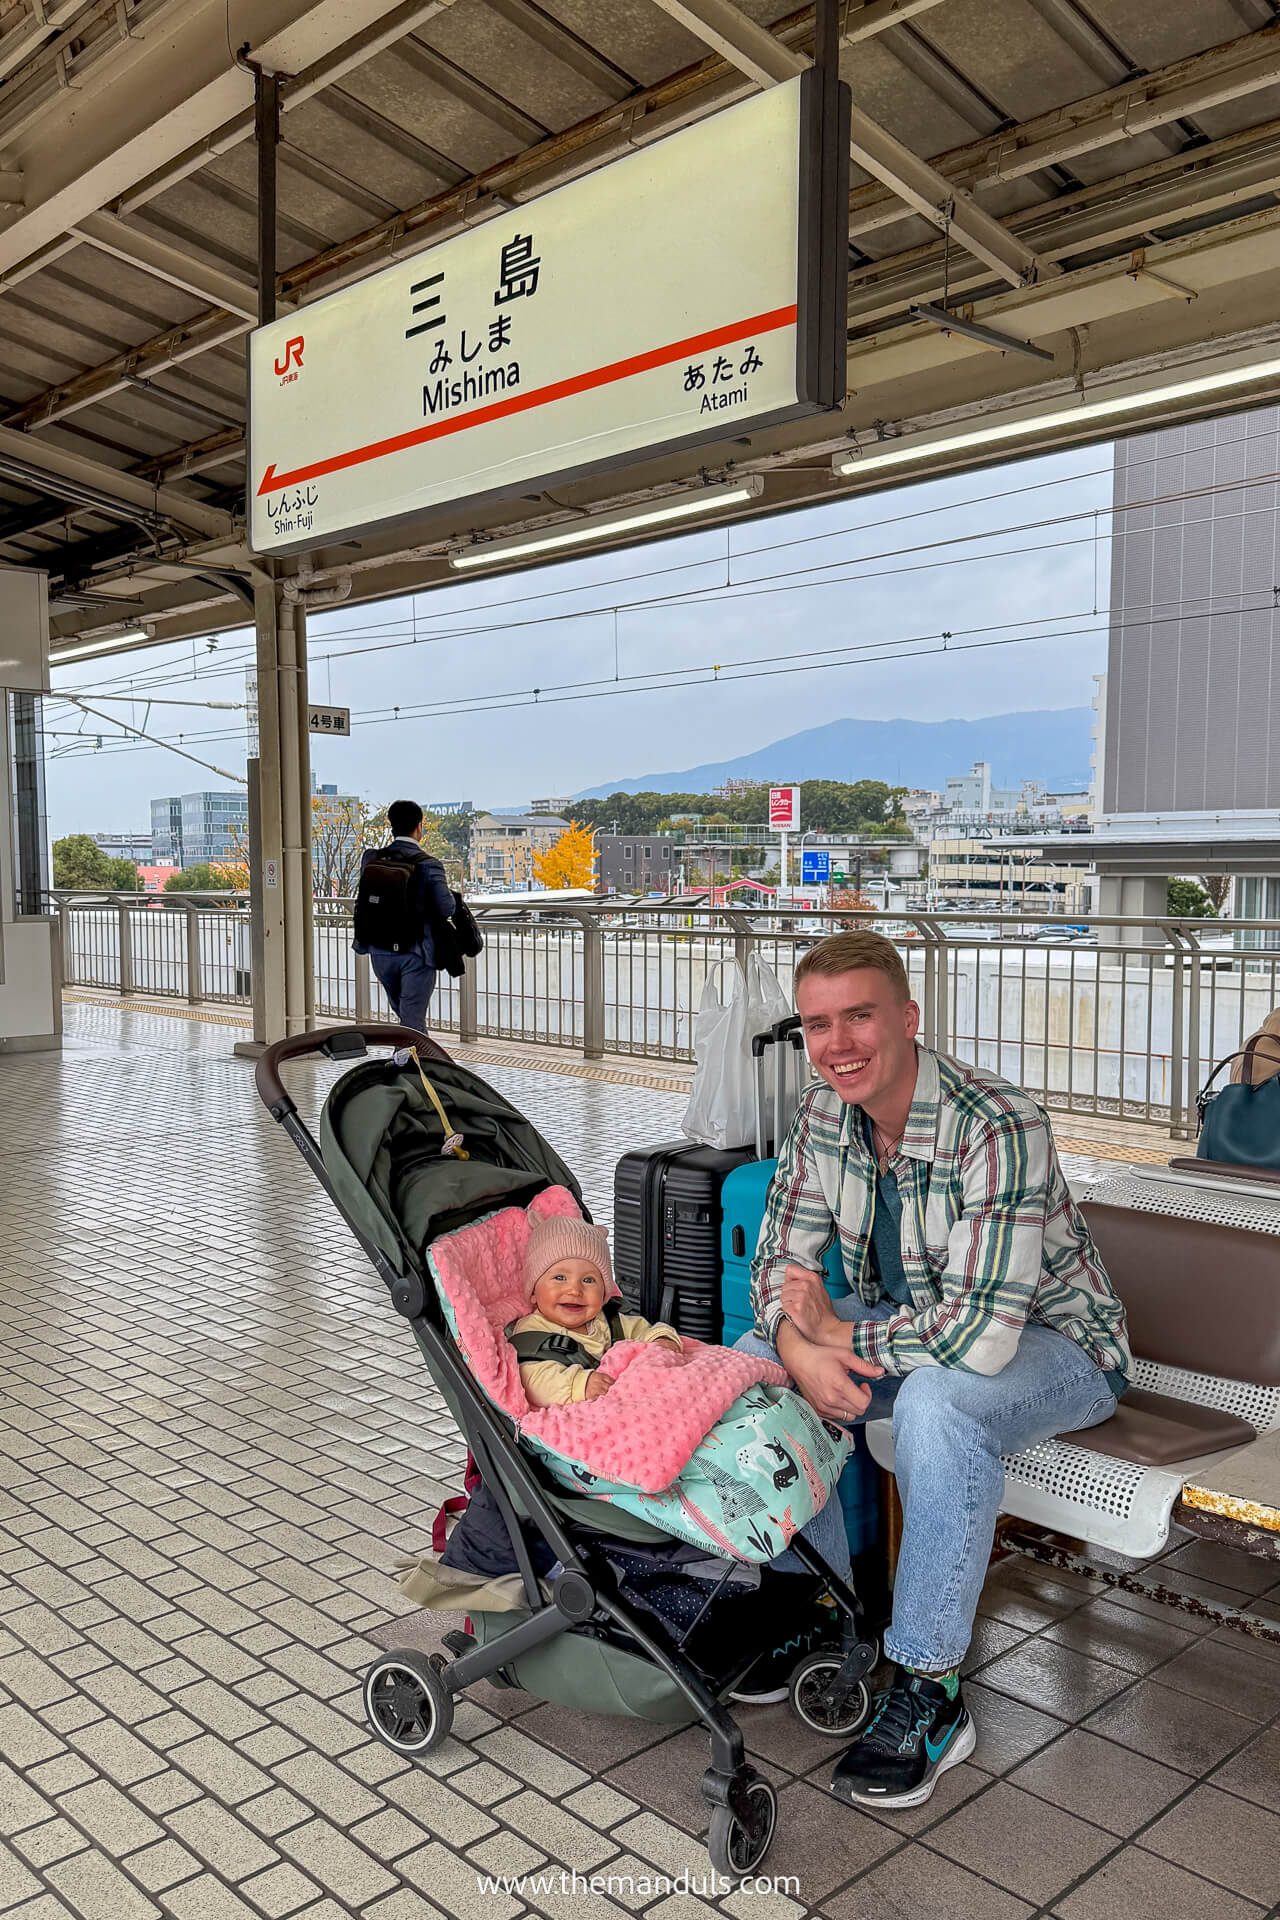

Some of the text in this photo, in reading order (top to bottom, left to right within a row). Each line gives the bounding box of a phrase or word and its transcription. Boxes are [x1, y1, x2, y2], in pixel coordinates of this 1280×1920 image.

[405, 234, 541, 339] 三島
[274, 335, 304, 376] JR
[429, 314, 512, 374] みしま
[423, 361, 520, 416] Mishima
[683, 345, 764, 391] あたみ
[699, 381, 748, 414] Atami
[267, 485, 319, 518] しんふじ
[274, 511, 313, 535] Shin-Fuji
[310, 714, 345, 730] 4号車
